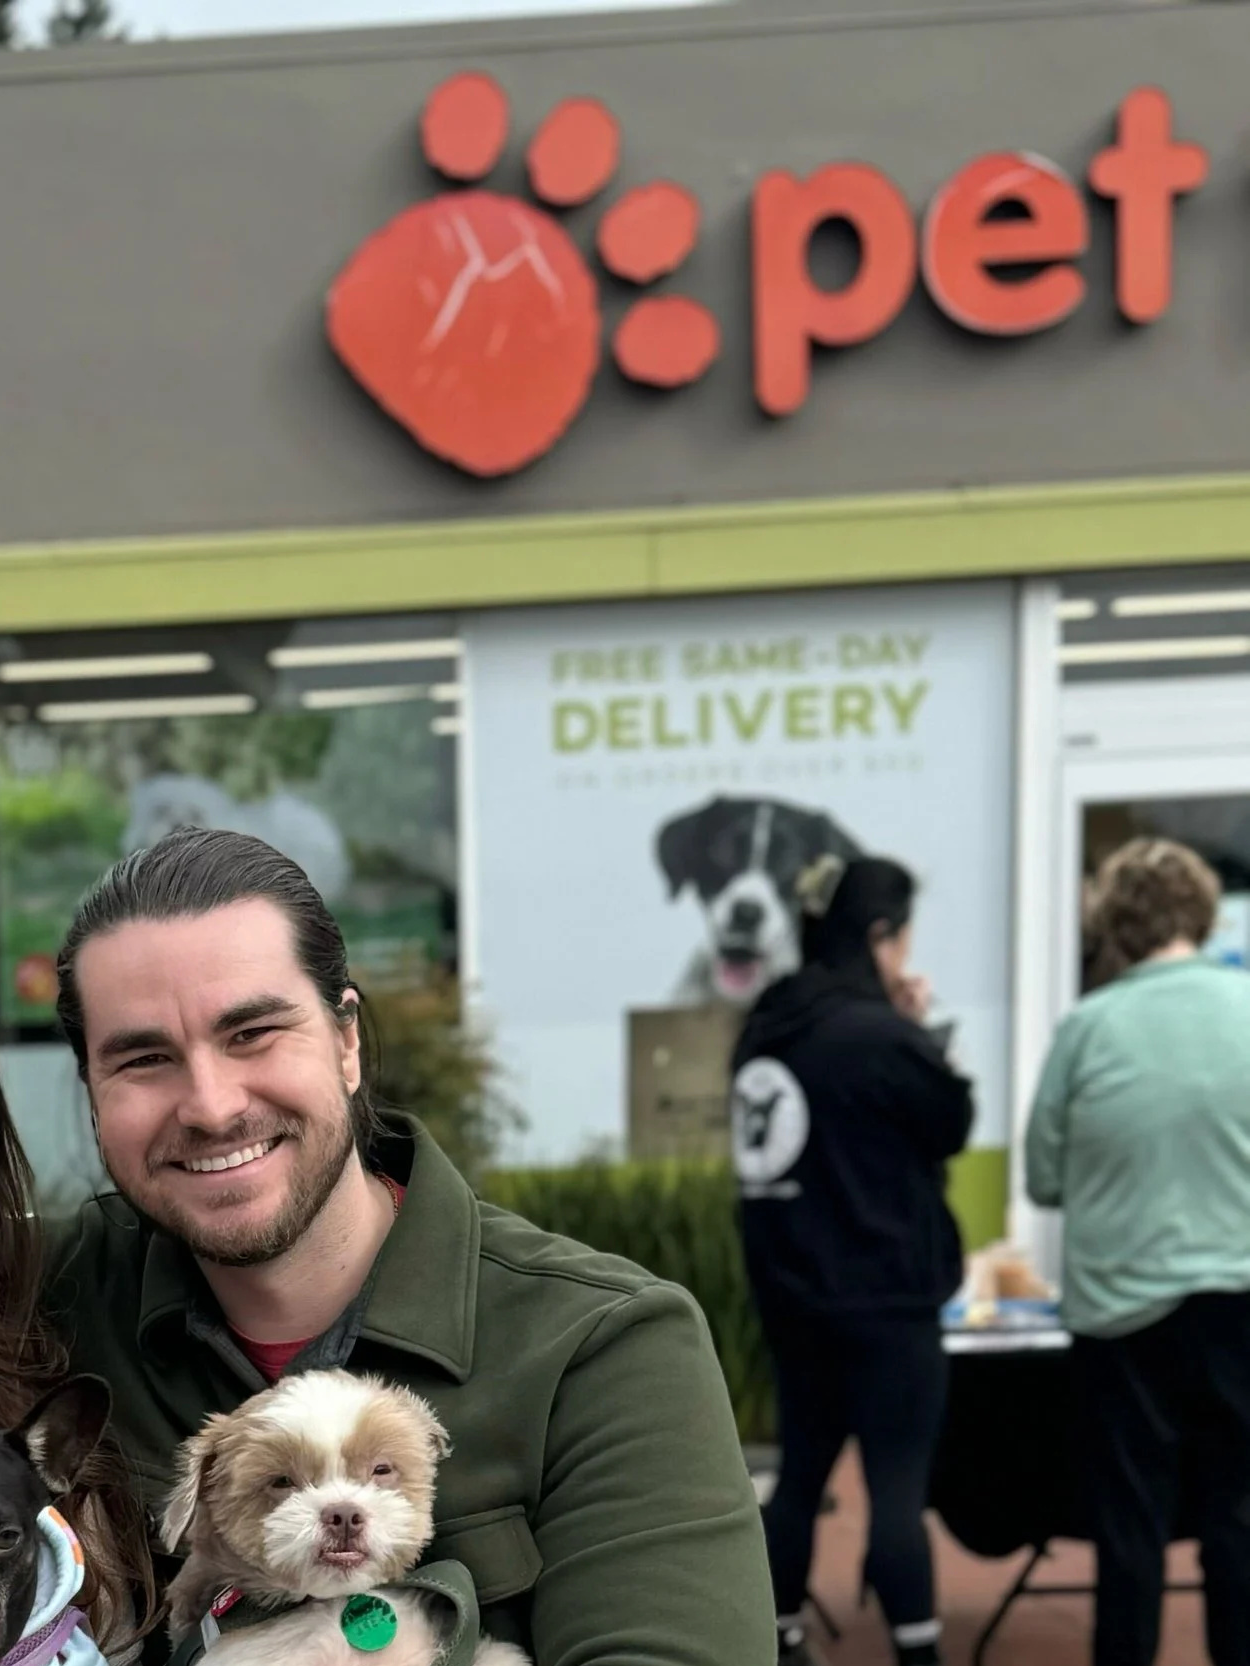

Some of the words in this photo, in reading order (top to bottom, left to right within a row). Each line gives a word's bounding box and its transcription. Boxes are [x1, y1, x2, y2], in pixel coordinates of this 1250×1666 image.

[753, 85, 1208, 415] pet
[553, 648, 662, 683] FREE
[553, 682, 930, 753] DELIVERY
